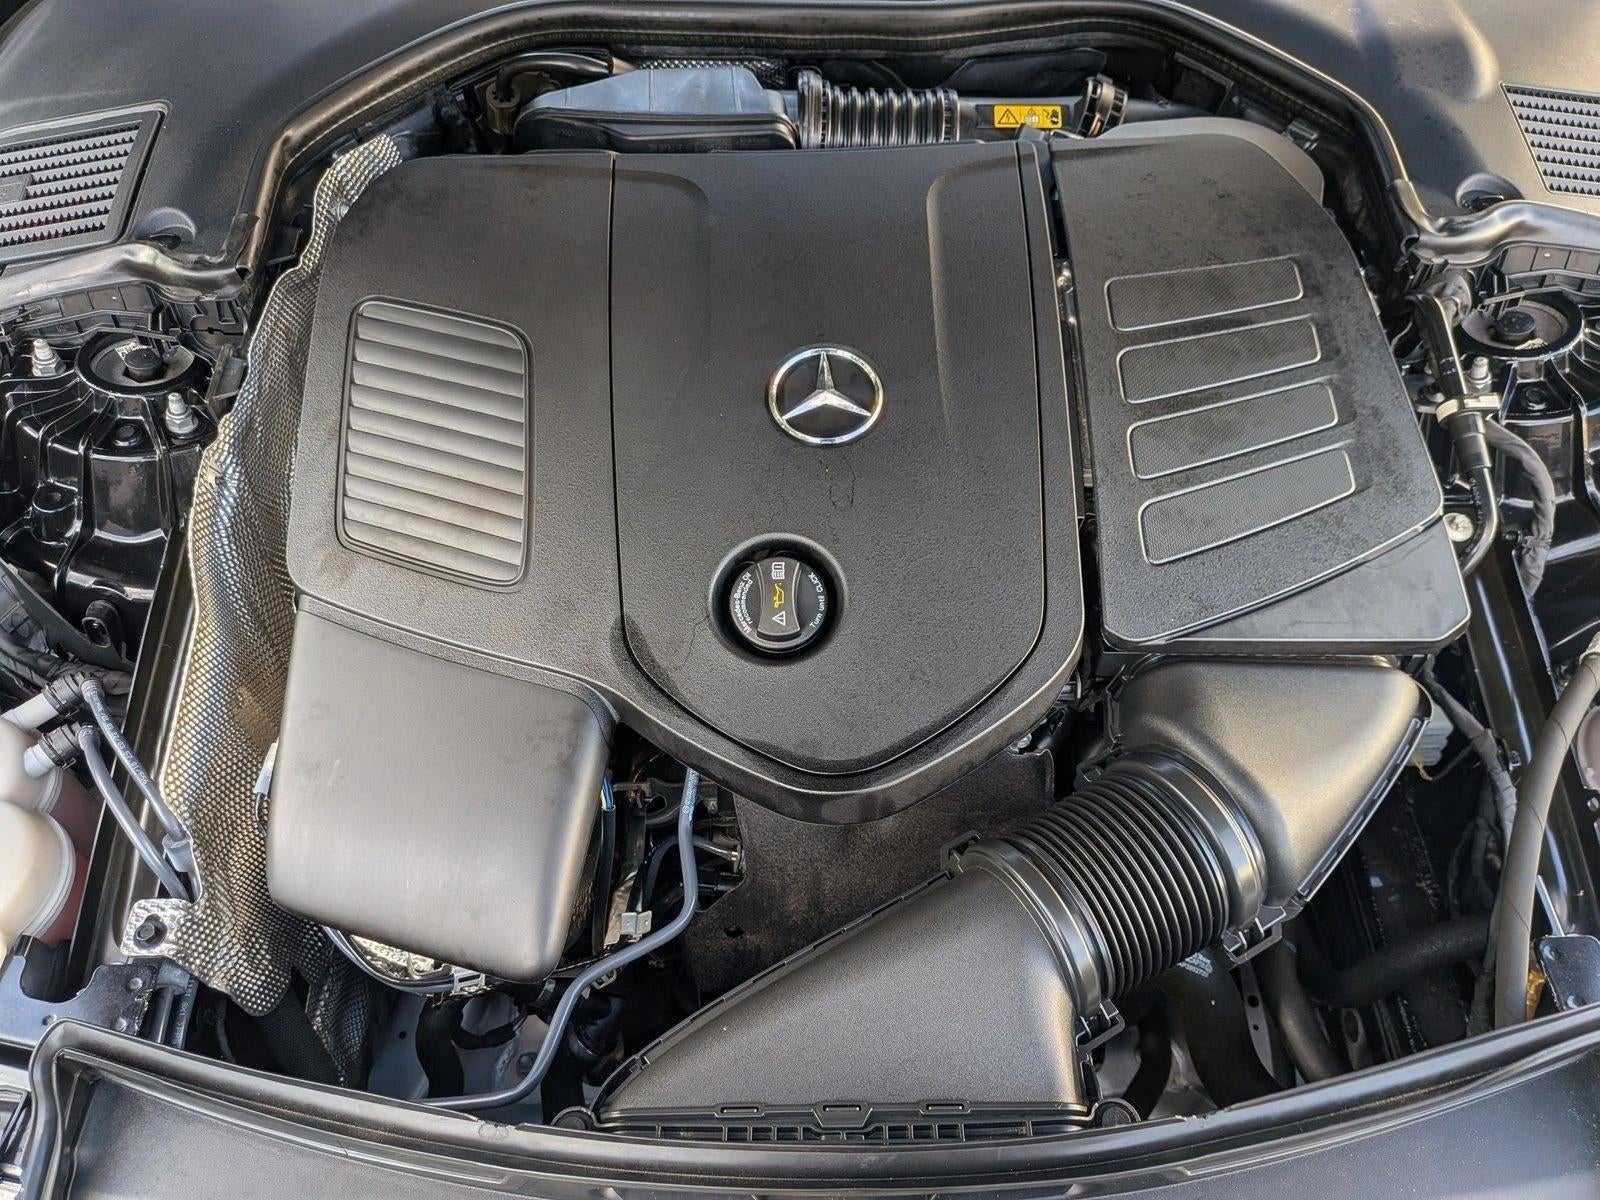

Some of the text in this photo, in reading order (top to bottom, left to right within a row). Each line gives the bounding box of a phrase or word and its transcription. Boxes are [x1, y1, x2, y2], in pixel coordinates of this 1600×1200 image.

[808, 572, 824, 593] CLICK
[734, 581, 752, 634] Mercedes-Benz
[741, 579, 753, 624] recommended
[809, 613, 823, 628] Turn
